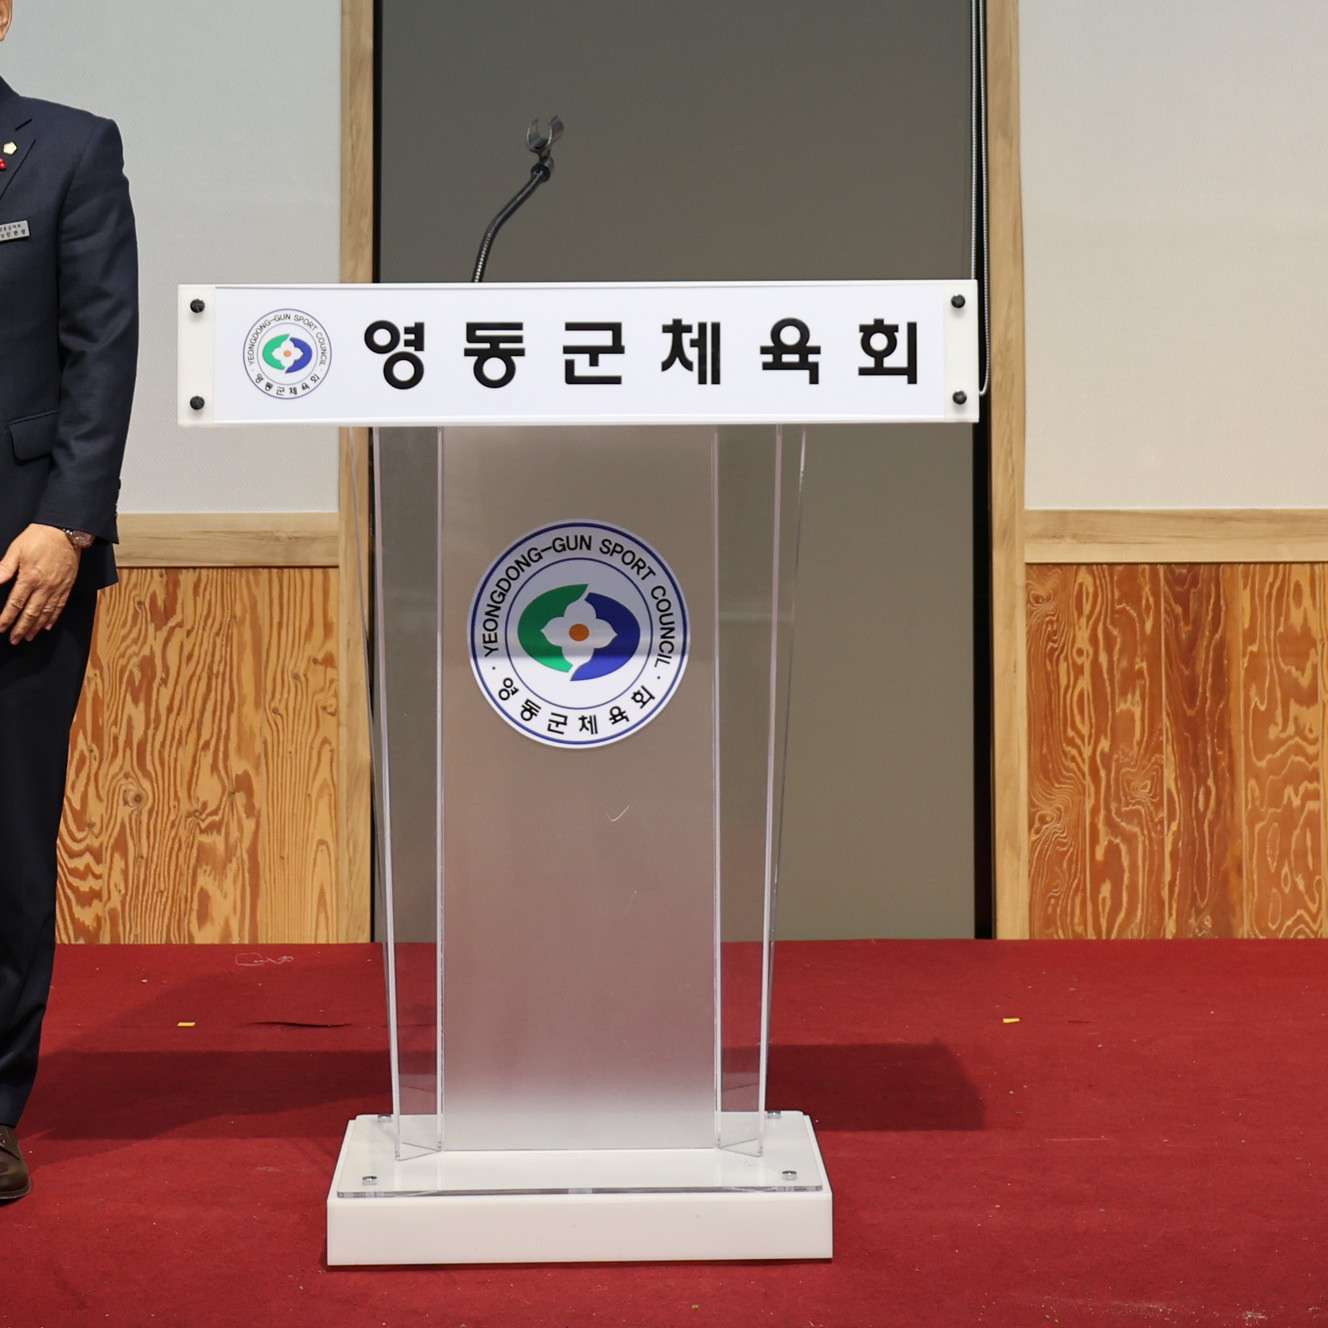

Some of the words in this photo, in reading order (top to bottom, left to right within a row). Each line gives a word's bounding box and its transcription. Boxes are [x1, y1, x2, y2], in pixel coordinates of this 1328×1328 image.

[293, 314, 318, 332] SPORT
[364, 318, 919, 390] 영동군체육회
[482, 534, 592, 658] YEONGDONG-GUN
[599, 538, 656, 582] SPORT
[650, 585, 676, 668] COUNCIL
[498, 677, 656, 735] 영동군체육회
